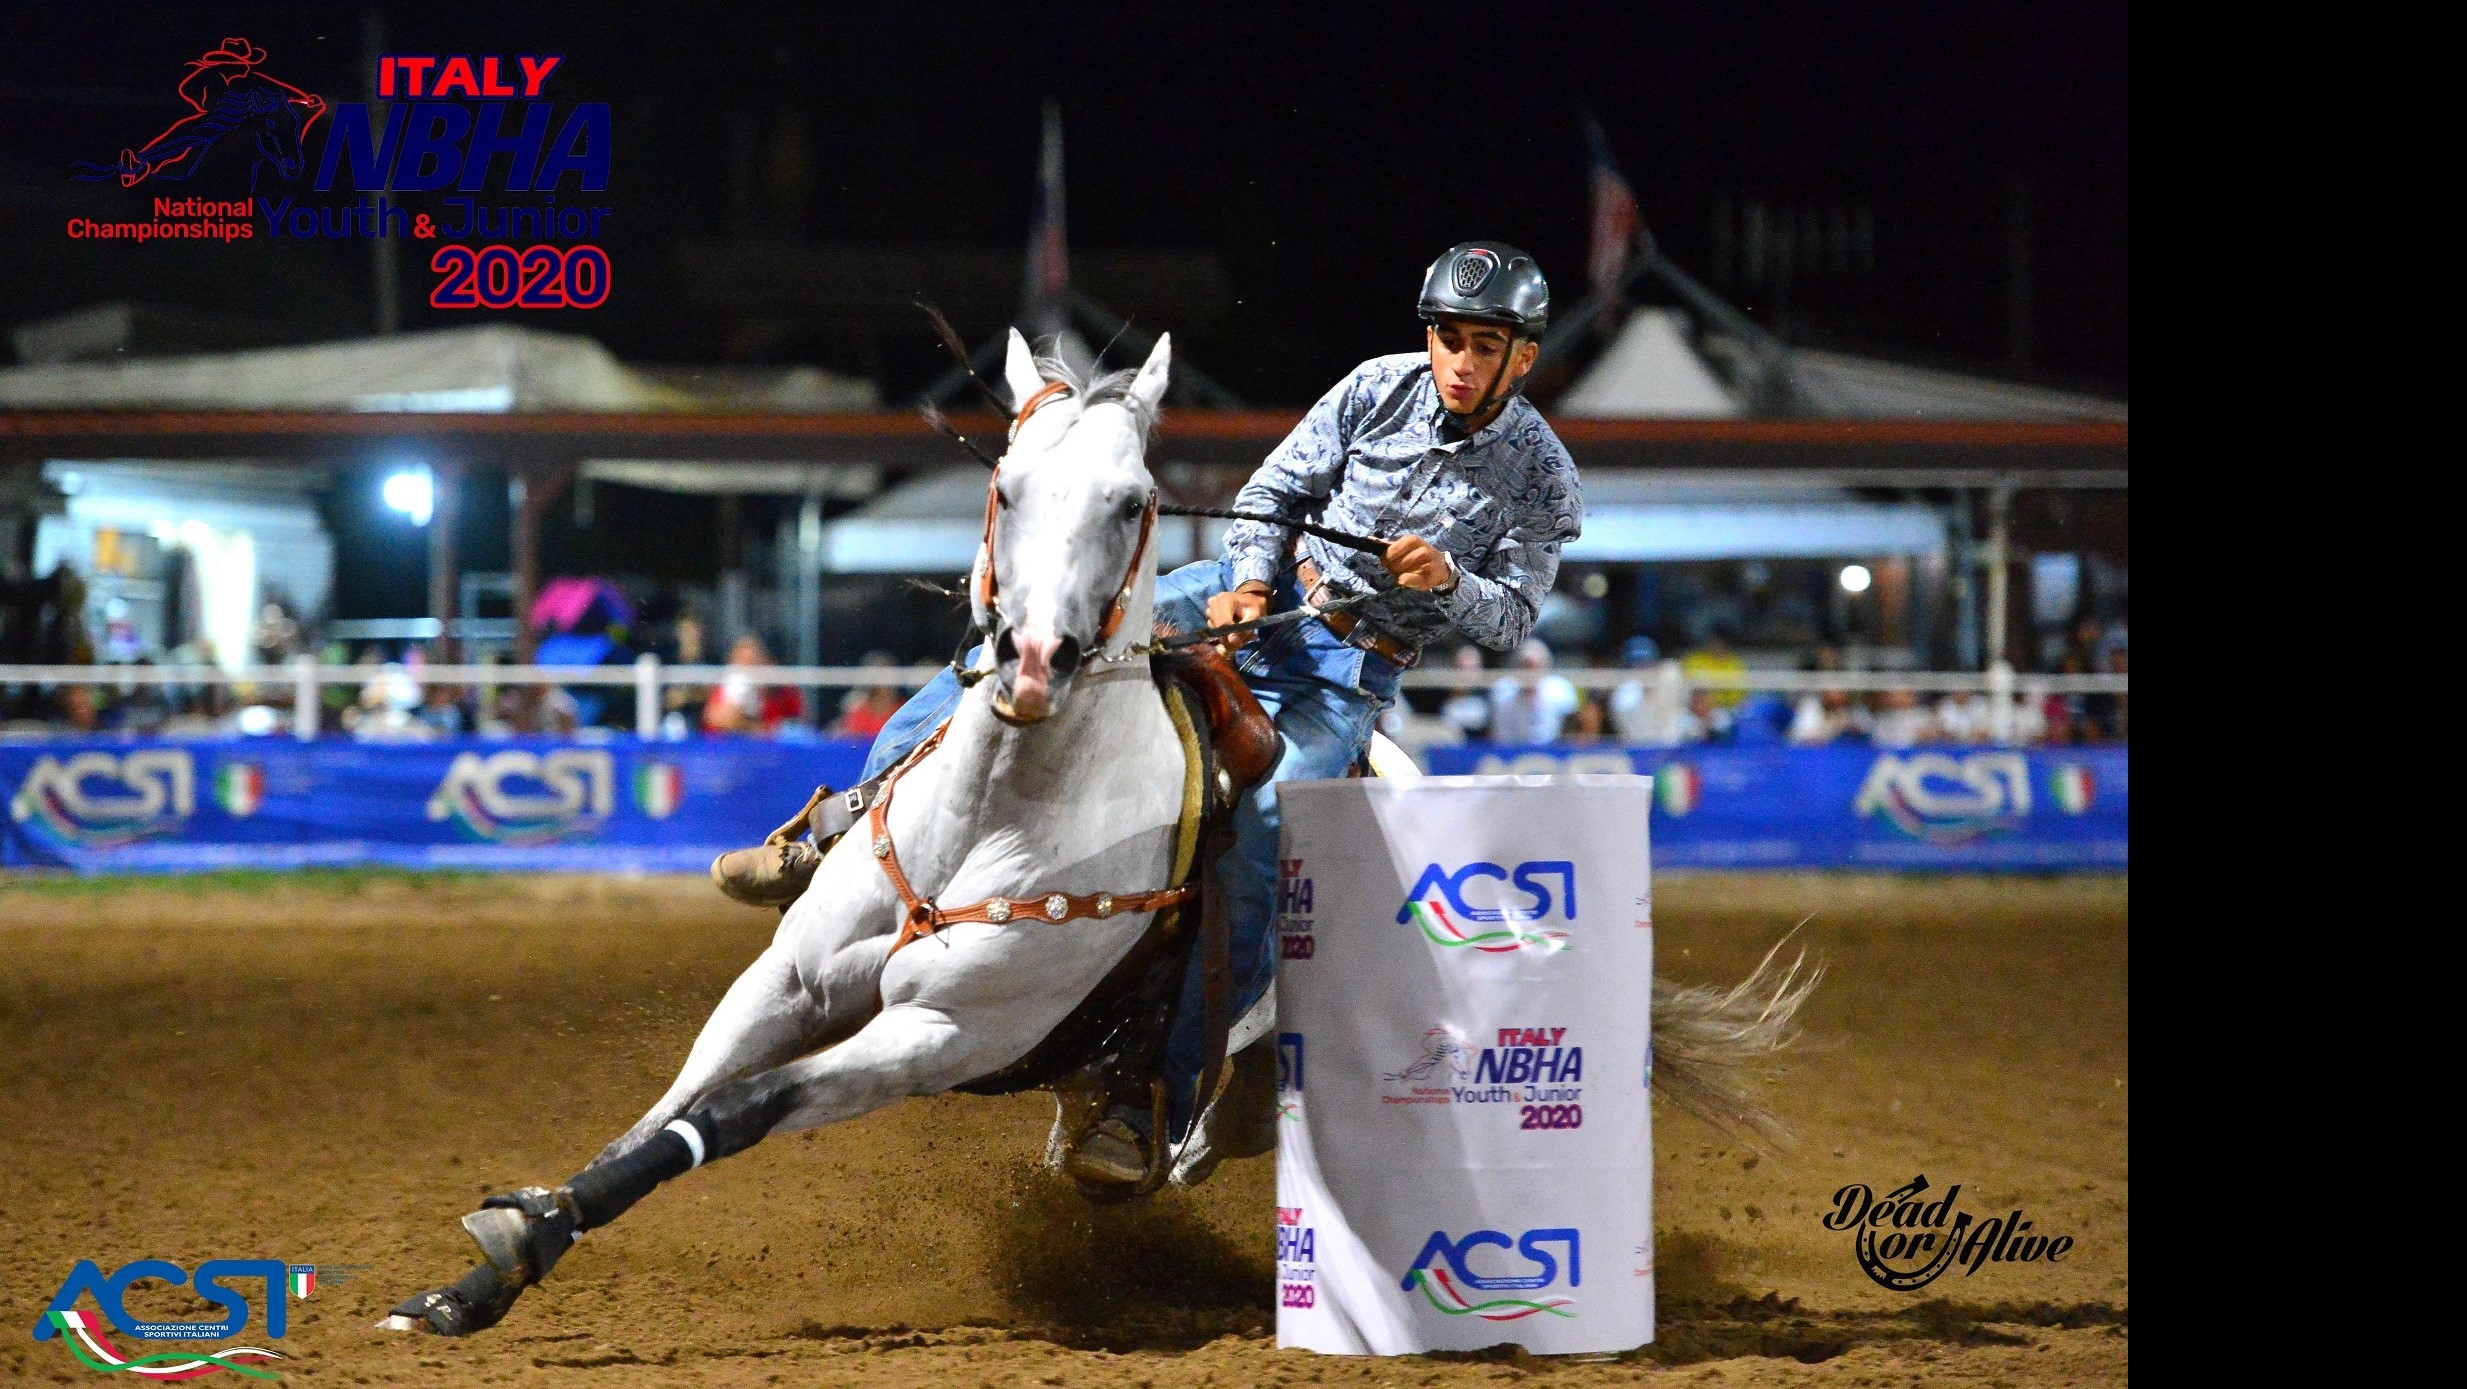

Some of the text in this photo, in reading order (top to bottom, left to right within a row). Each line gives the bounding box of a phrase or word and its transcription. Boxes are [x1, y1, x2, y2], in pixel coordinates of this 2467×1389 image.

[1396, 861, 1577, 925] ACSI
[1498, 1027, 1567, 1047] ITALY
[1474, 1046, 1583, 1084] NBHA
[1452, 1086, 1512, 1104] Youth
[1523, 1084, 1582, 1103] Junior
[1520, 1103, 1583, 1130] 2020
[1401, 1228, 1581, 1292] ACSI
